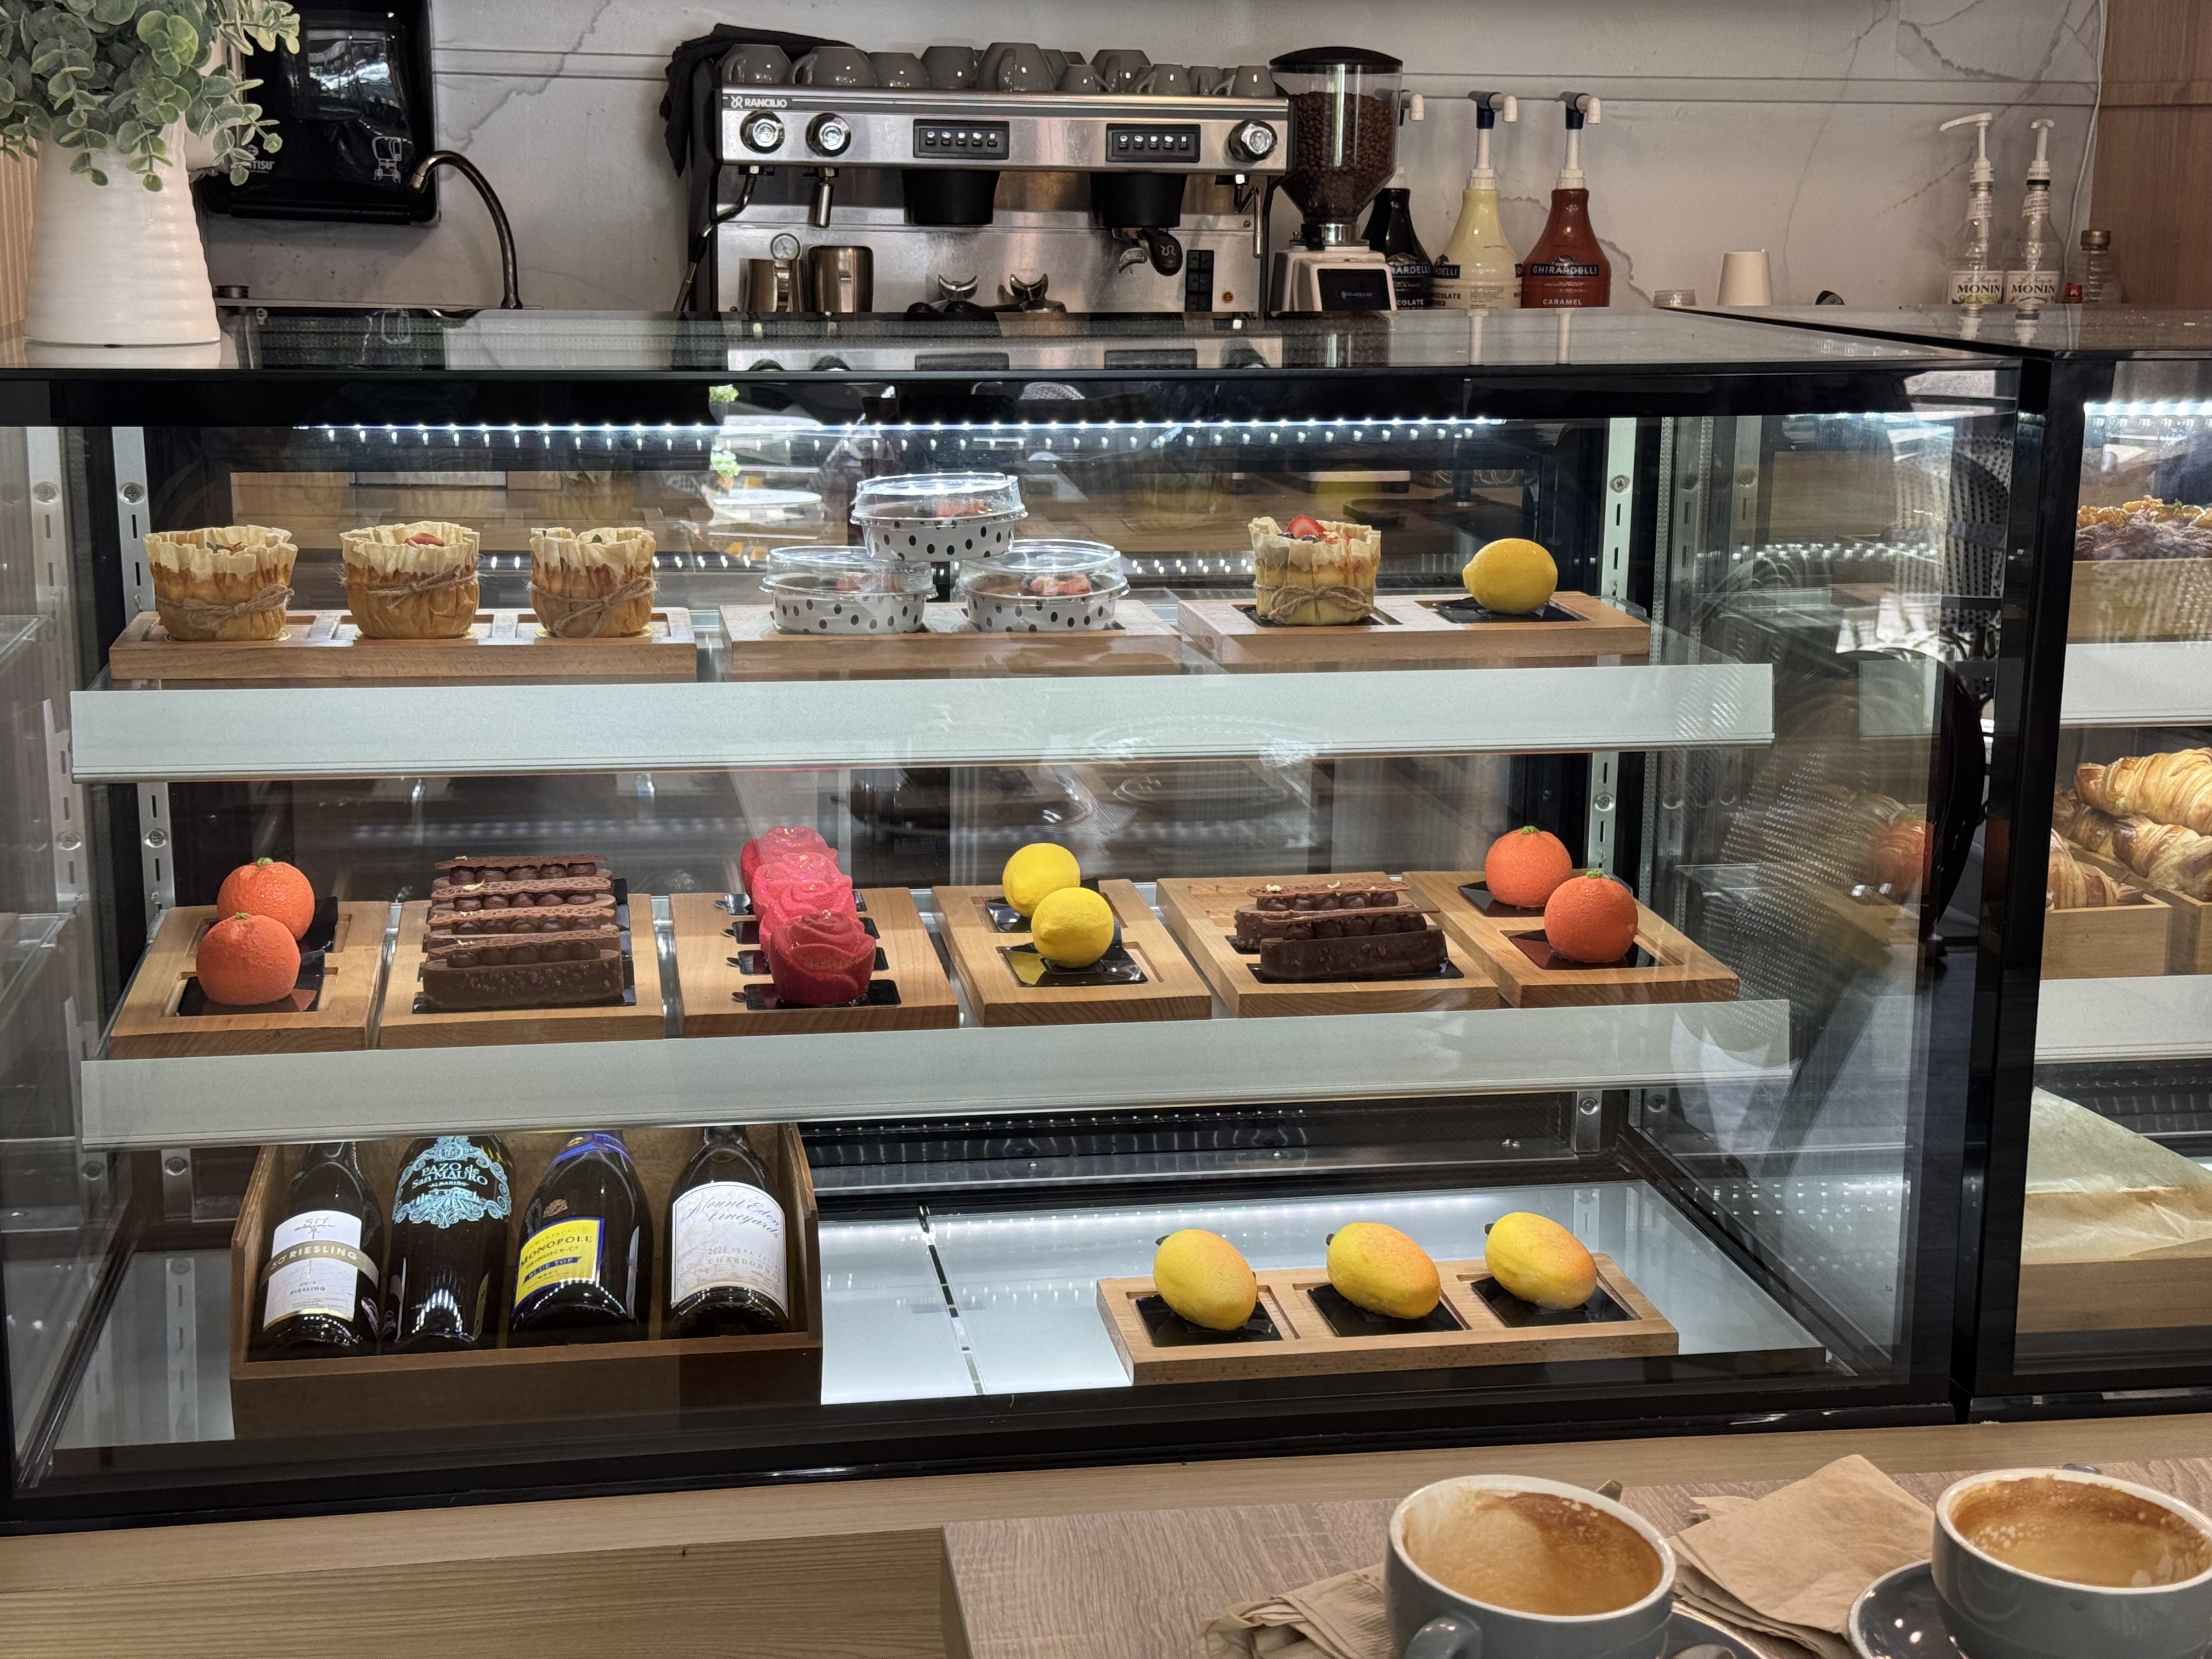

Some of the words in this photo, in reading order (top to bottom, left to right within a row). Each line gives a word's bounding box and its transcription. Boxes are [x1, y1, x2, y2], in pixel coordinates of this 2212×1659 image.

[744, 98, 788, 108] RANCILIO
[1532, 266, 1597, 275] GHIRARDELLI
[1957, 284, 2001, 294] MONIN
[2011, 284, 2056, 294] MONIN
[422, 1163, 461, 1176] PAZO
[465, 1165, 480, 1175] de
[412, 1176, 431, 1189] San
[435, 1170, 488, 1186] MAURO
[681, 1197, 746, 1221] Mount
[747, 1199, 780, 1227] Eden
[708, 1209, 780, 1238] Vineyards
[289, 1245, 358, 1260] RIESLING
[520, 1235, 593, 1268] MONOPOLE
[554, 1257, 574, 1267] TOP
